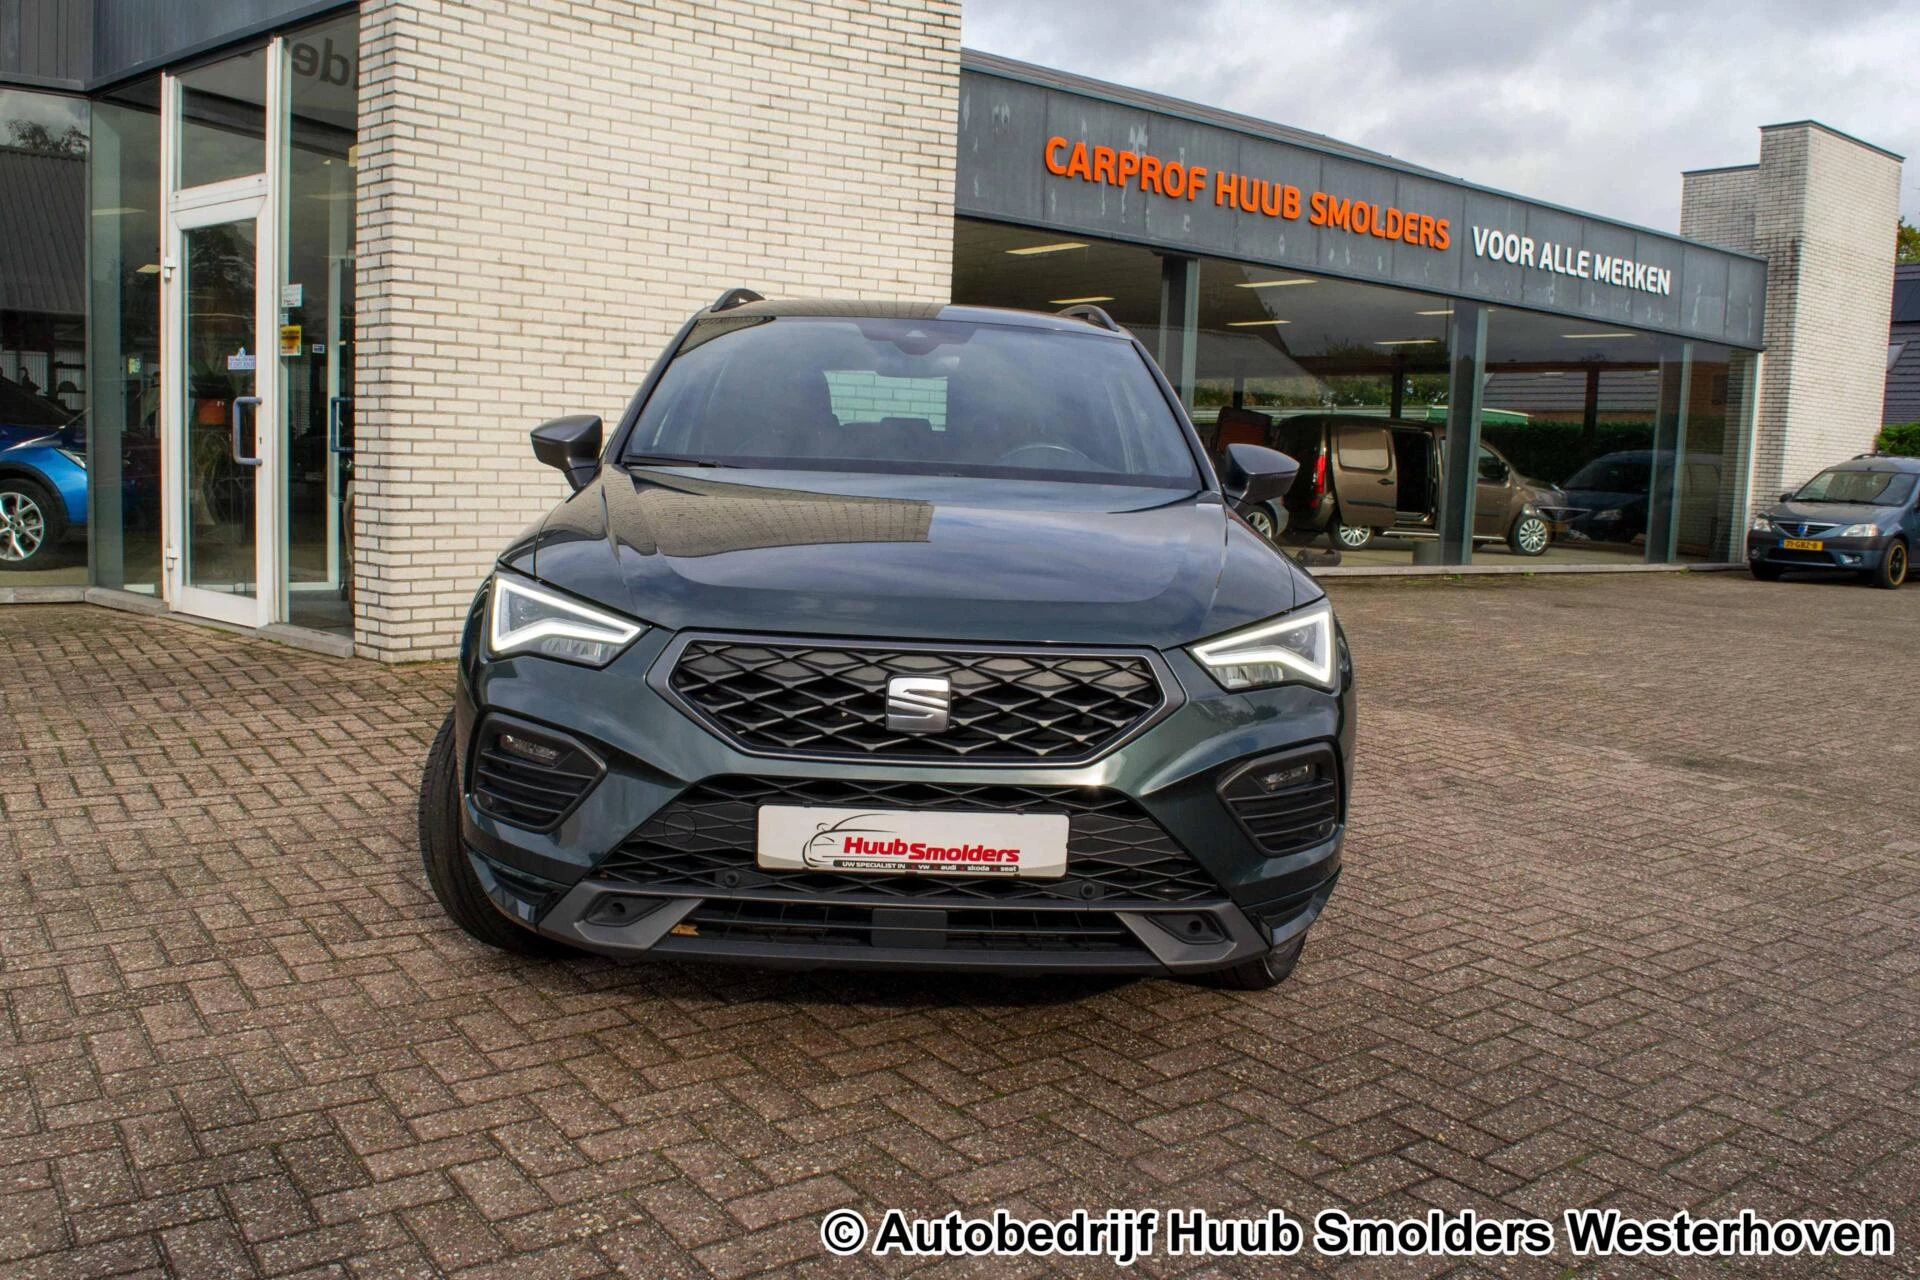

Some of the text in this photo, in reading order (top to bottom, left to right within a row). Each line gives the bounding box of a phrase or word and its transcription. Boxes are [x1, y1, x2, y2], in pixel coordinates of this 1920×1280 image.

[1044, 136, 1450, 250] CARPROF HUUB SMOLDERS
[1472, 225, 1672, 296] VOOR ALLE MERKEN
[856, 861, 897, 869] SPECIALIST
